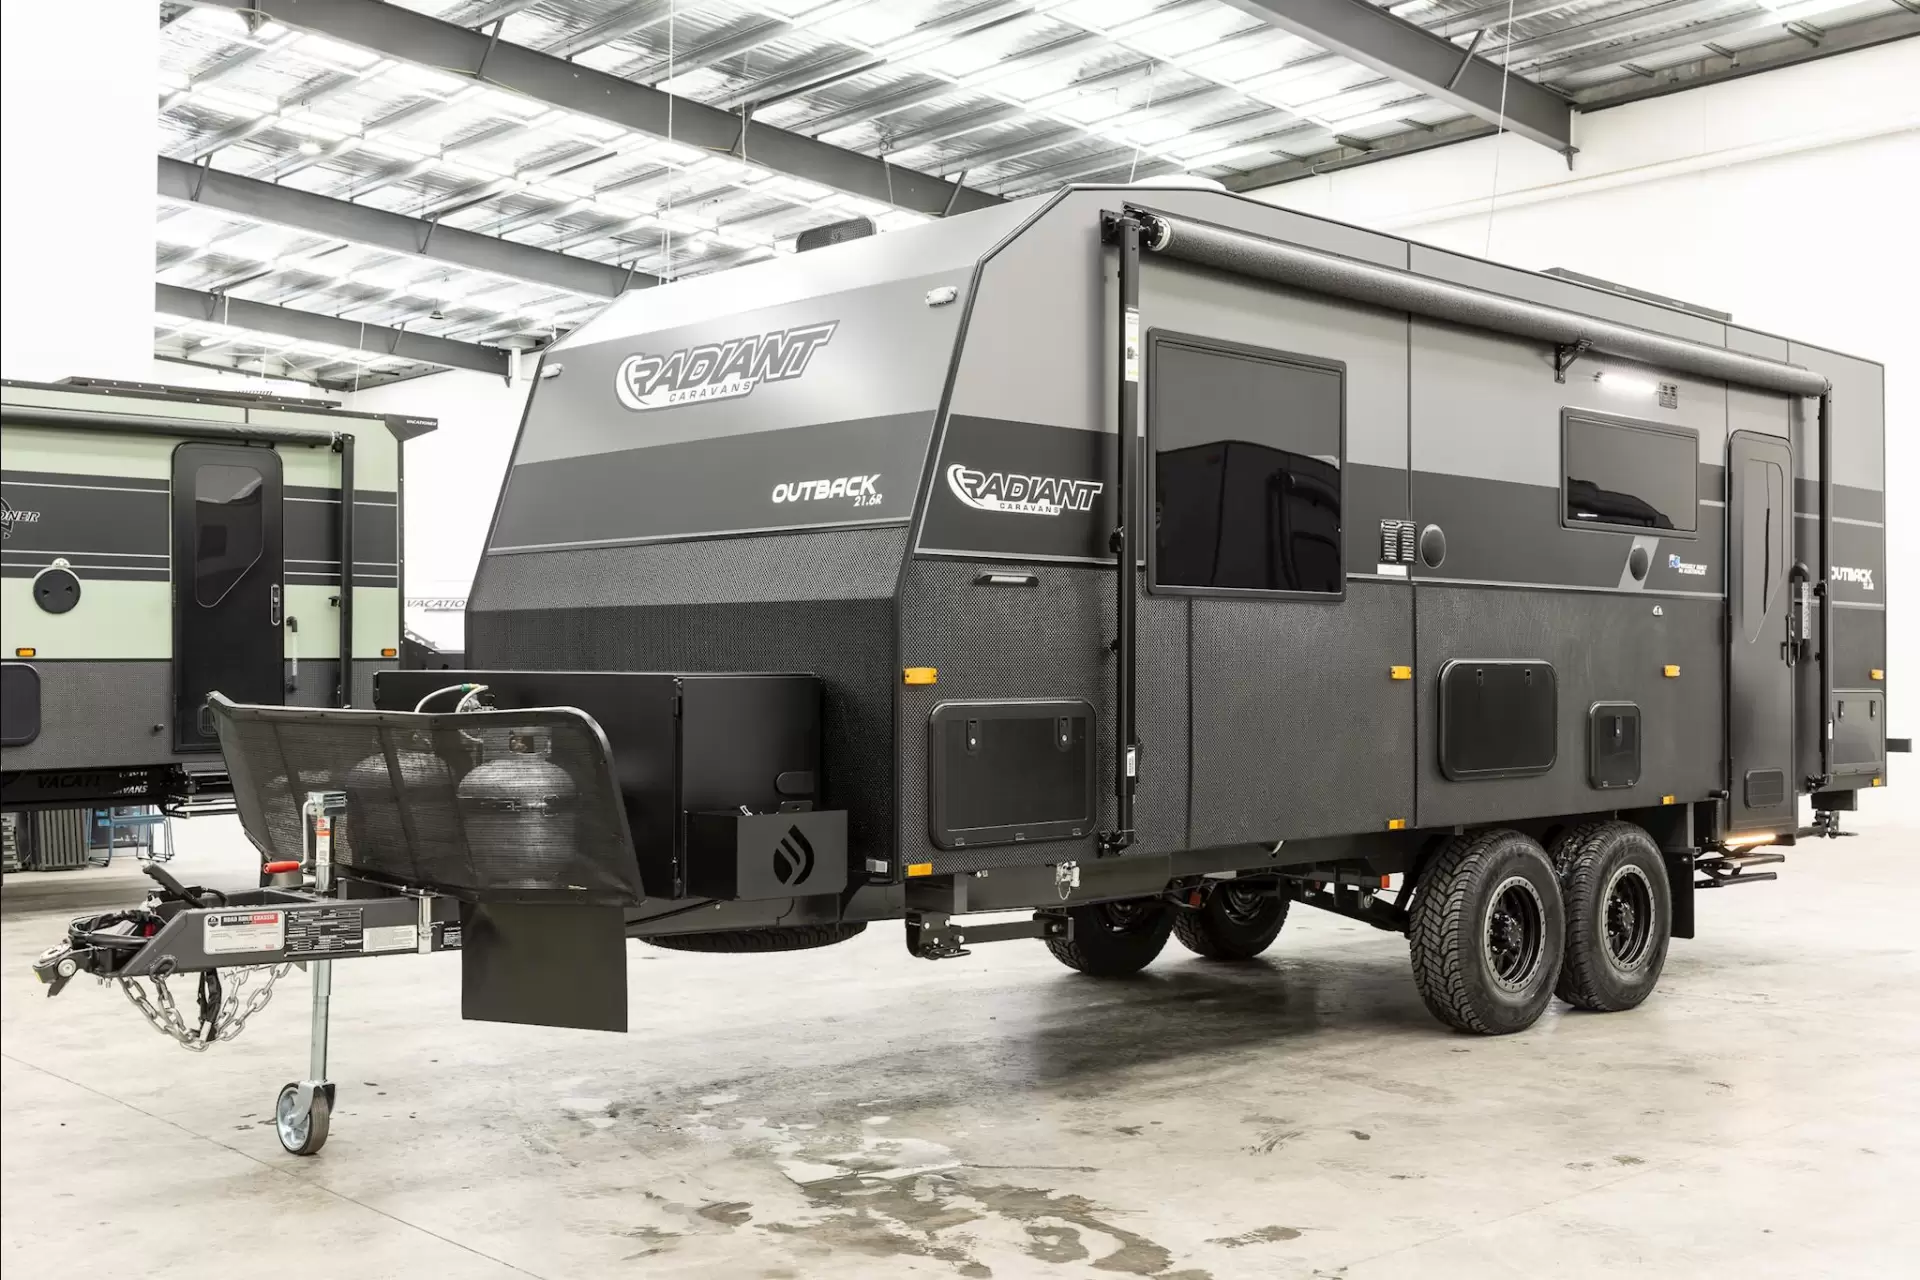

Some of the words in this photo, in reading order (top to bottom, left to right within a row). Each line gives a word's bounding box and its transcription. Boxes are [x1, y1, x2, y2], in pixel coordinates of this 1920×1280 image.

[628, 321, 839, 397] RADIANT
[668, 381, 752, 403] CARAVANS
[772, 473, 881, 503] OUTBACK
[853, 493, 883, 507] 21.6R
[960, 470, 1103, 510] RADIANT
[999, 501, 1060, 514] CARAVANS
